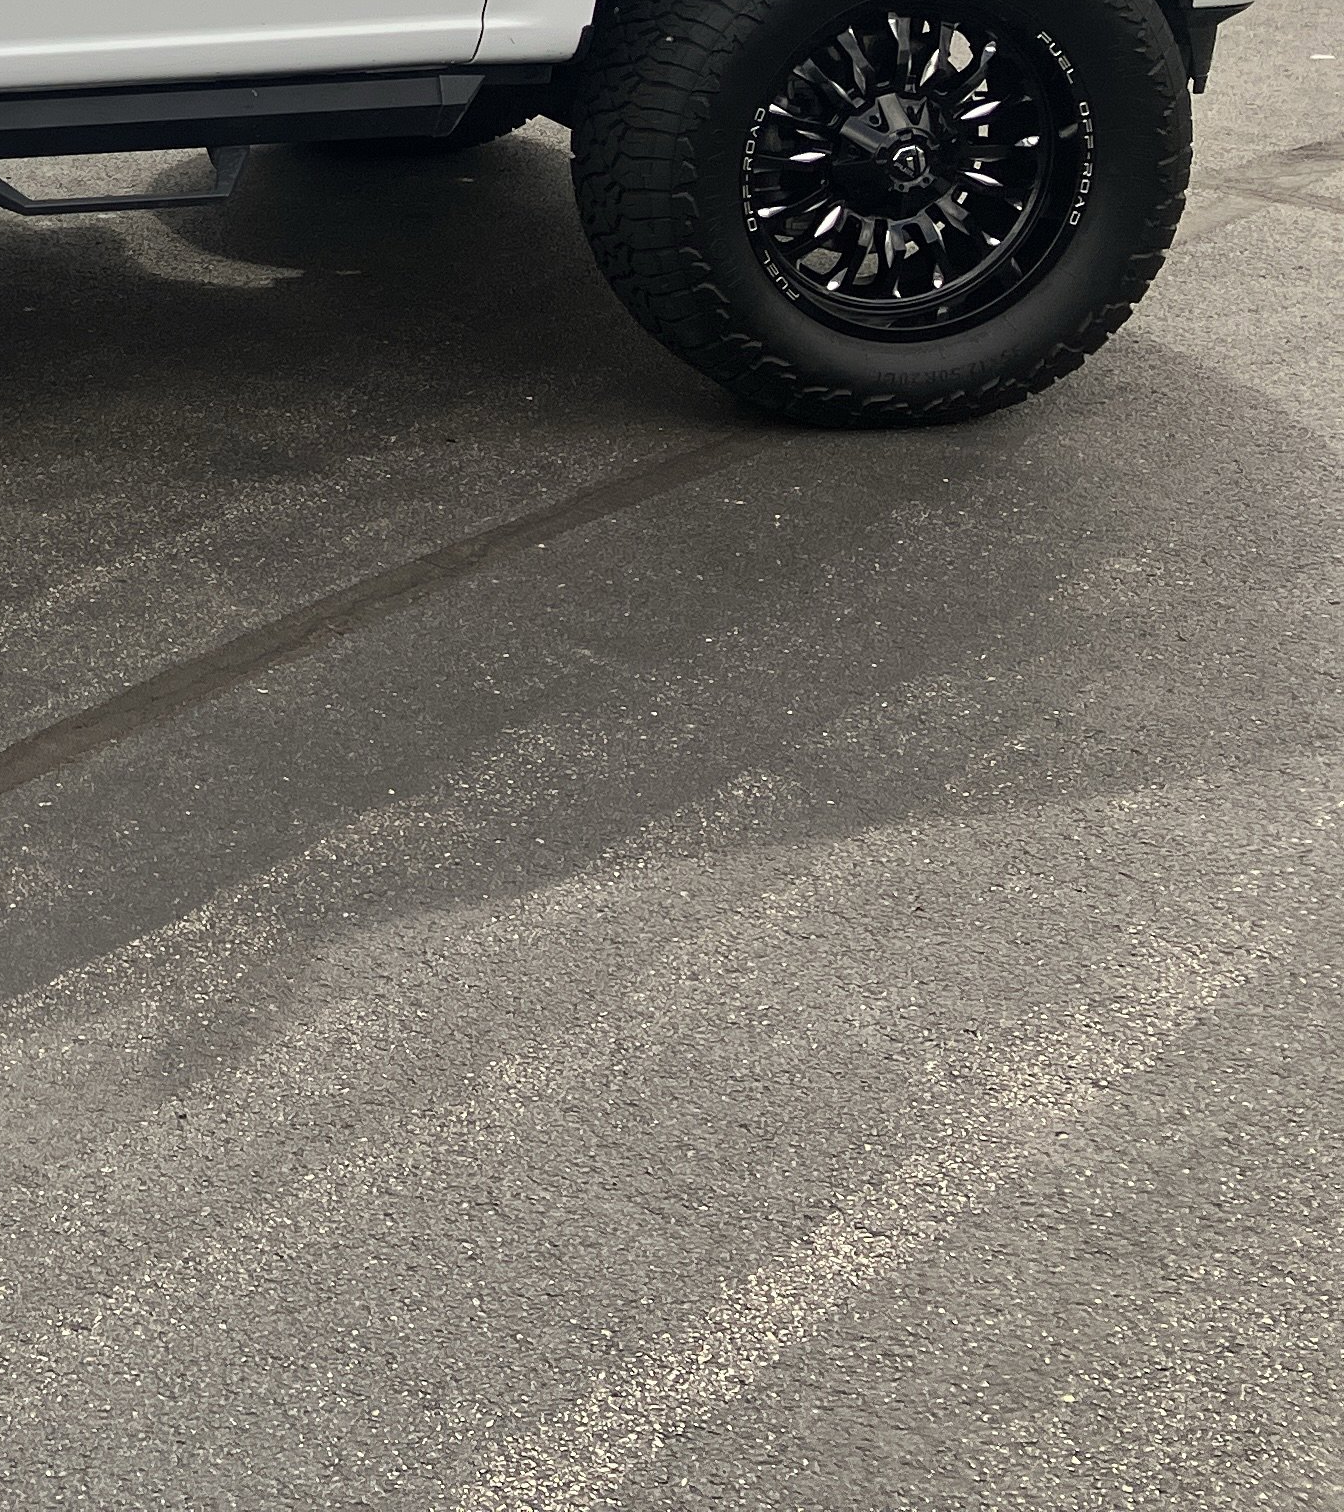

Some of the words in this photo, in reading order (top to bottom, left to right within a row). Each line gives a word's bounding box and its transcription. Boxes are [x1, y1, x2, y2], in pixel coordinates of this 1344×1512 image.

[743, 106, 767, 233] OFF-ROAD
[1035, 29, 1076, 86] FUEL
[1068, 99, 1095, 228] OFF-ROAD
[759, 248, 801, 302] FUEL
